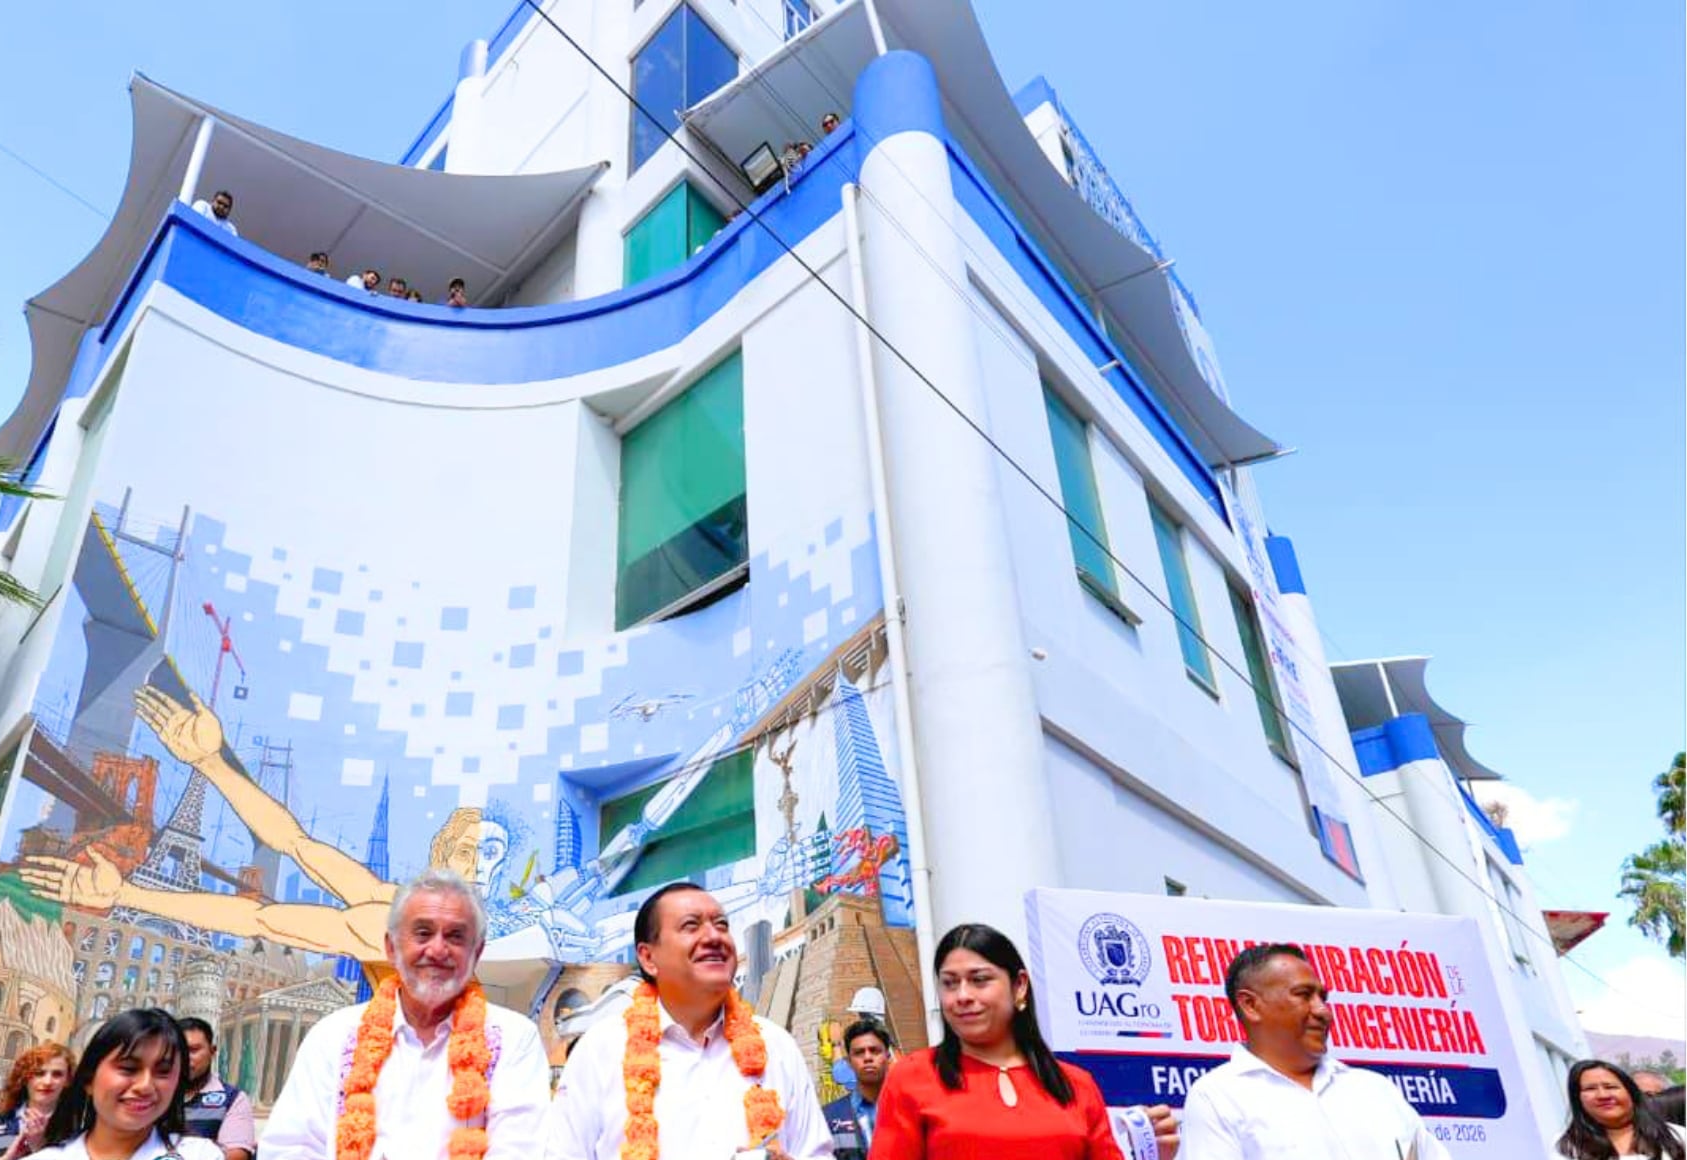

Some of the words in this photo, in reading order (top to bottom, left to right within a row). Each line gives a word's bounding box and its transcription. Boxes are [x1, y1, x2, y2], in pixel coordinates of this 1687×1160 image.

[1161, 935, 1448, 999] REINURACIÓN
[1075, 991, 1161, 1019] UAGro
[1434, 1124, 1452, 1142] de
[1452, 1124, 1487, 1143] 2026
